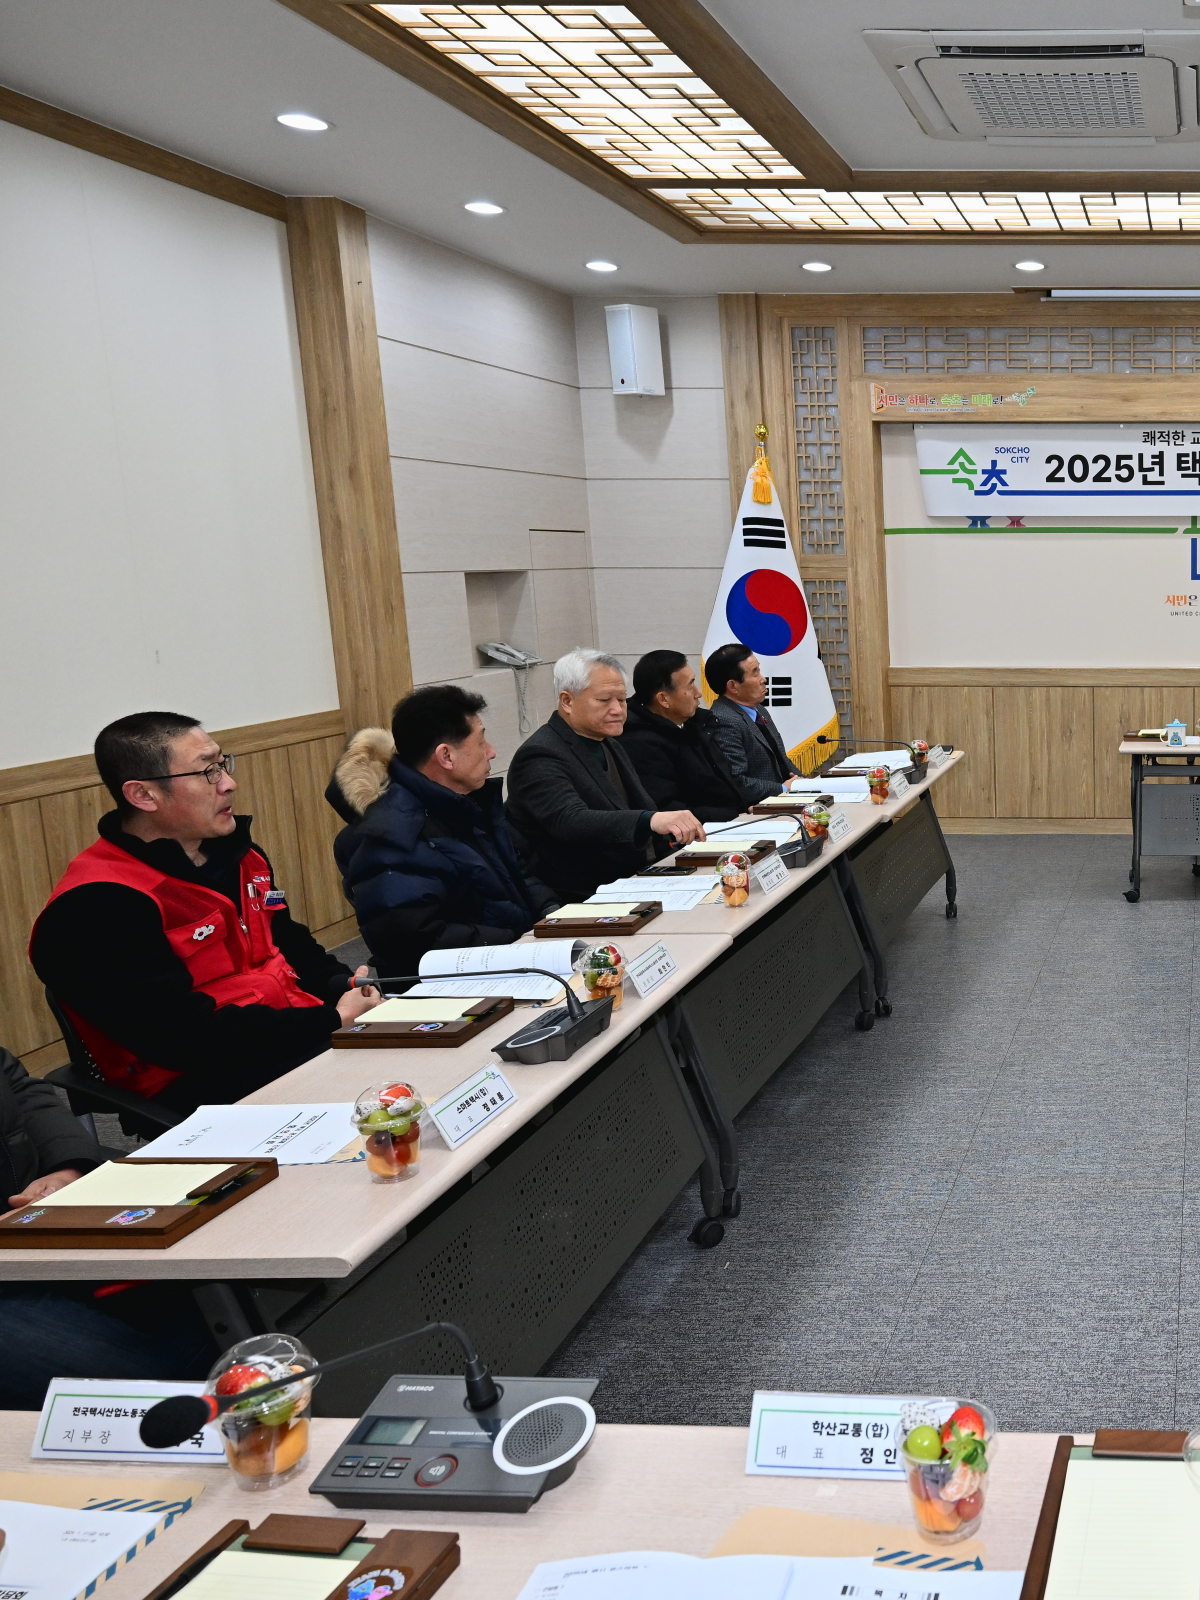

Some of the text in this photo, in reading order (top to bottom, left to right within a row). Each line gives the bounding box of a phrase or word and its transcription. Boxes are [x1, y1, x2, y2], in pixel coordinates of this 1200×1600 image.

[1142, 430, 1186, 446] 쾌적한
[994, 446, 1030, 454] SOKCHO
[1010, 456, 1030, 464] CITY
[1045, 451, 1166, 486] 2025년
[1164, 594, 1198, 607] 시민은
[72, 1407, 148, 1418] 전국택시산업노동조
[812, 1420, 890, 1440] 학산교통(합)
